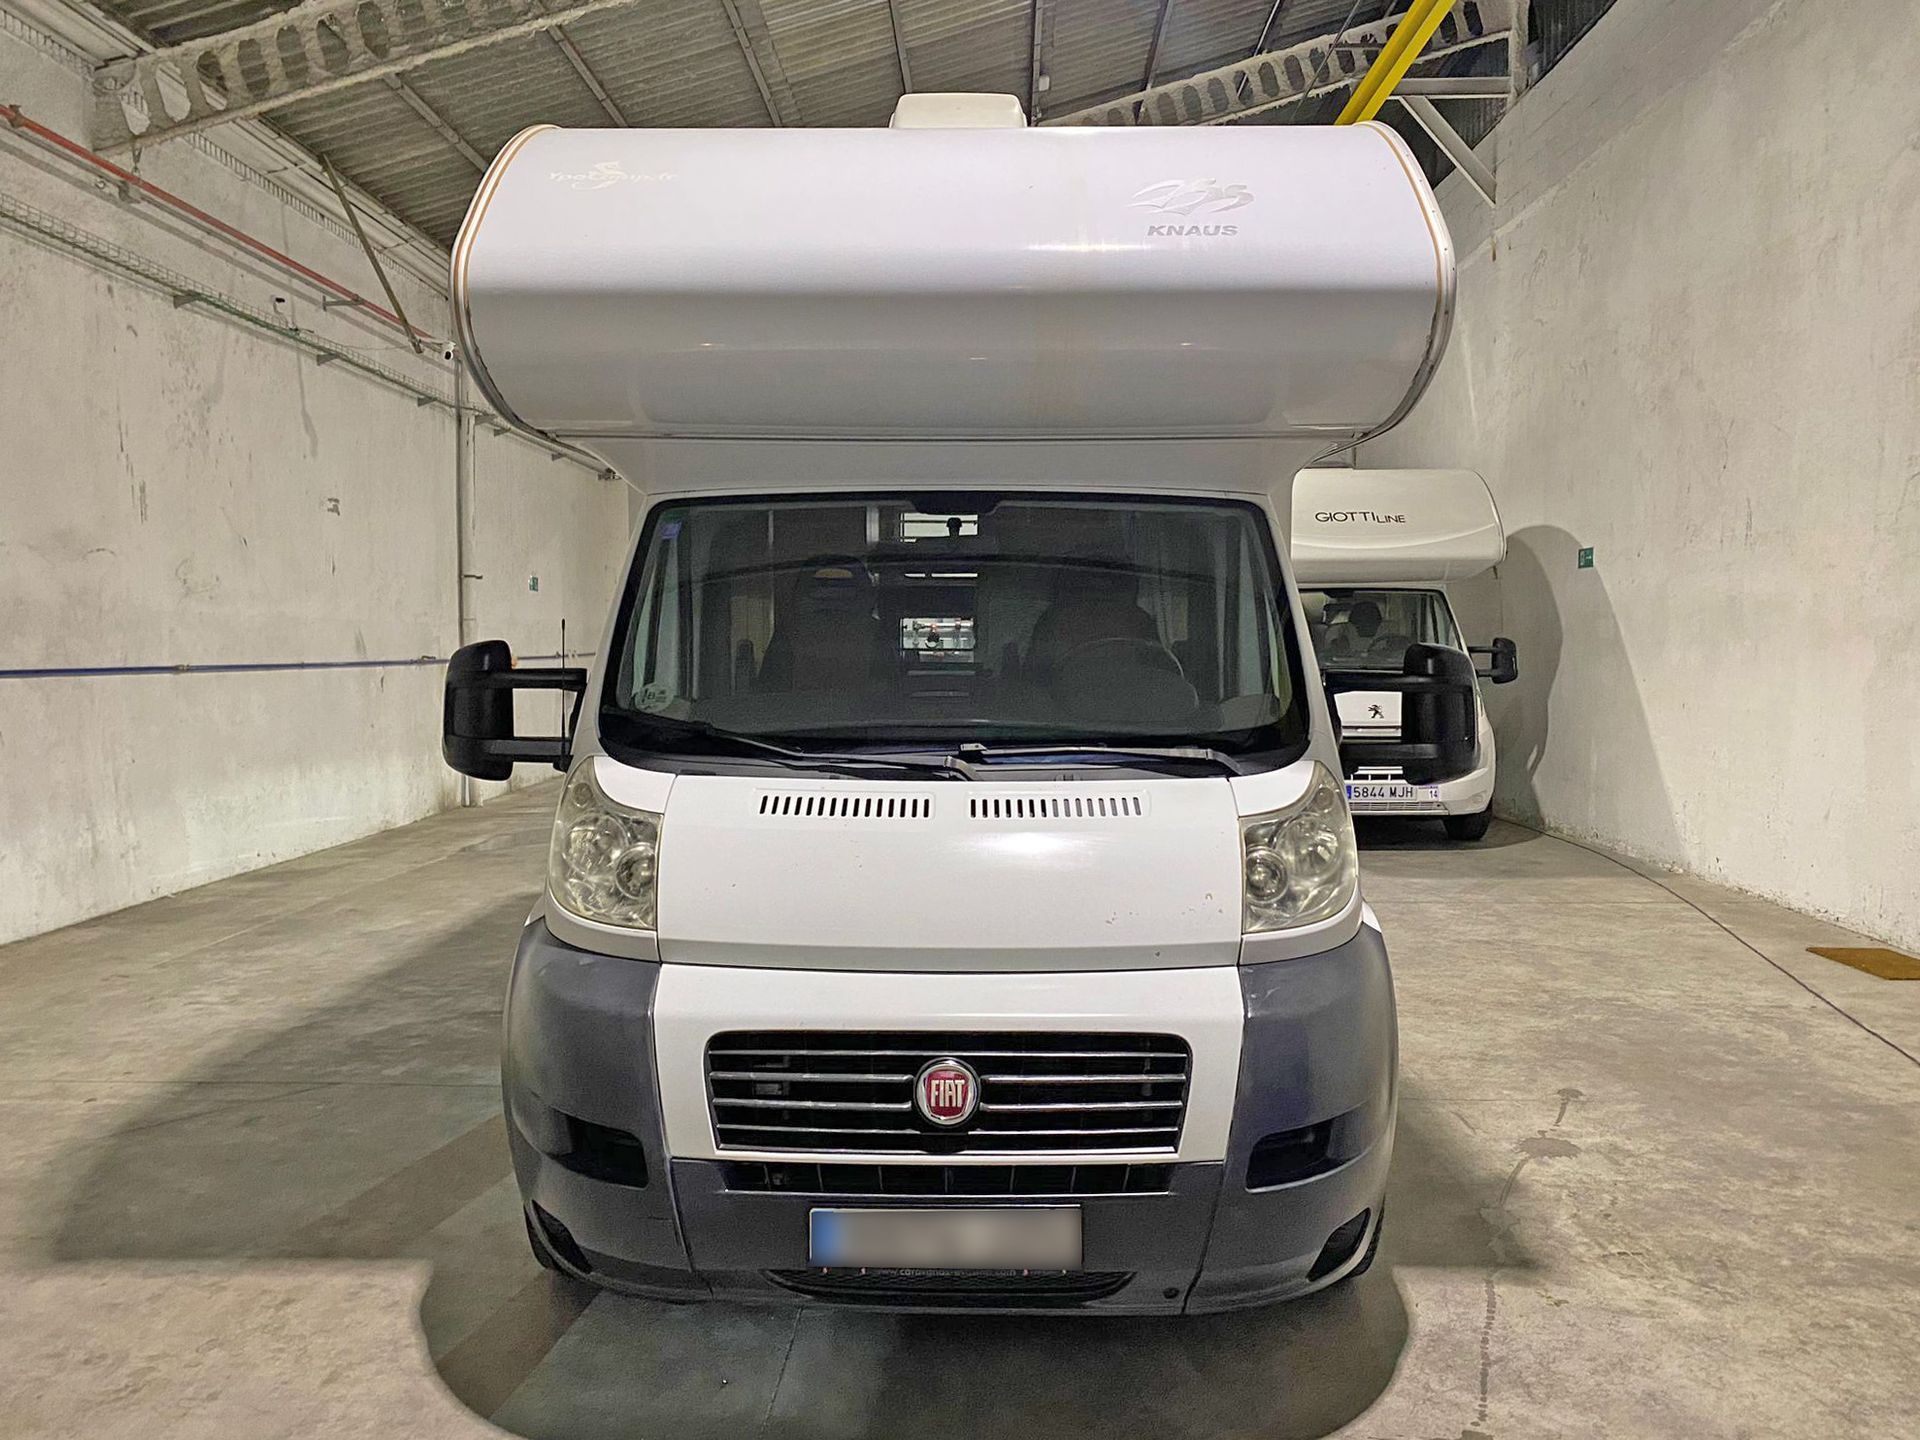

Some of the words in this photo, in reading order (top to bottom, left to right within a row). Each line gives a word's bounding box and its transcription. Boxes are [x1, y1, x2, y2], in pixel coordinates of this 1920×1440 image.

[1147, 225, 1239, 236] KNAUS
[1353, 786, 1384, 798] 5844
[1390, 786, 1413, 798] MJH
[1429, 789, 1438, 798] 14
[930, 1079, 966, 1107] FIAT
